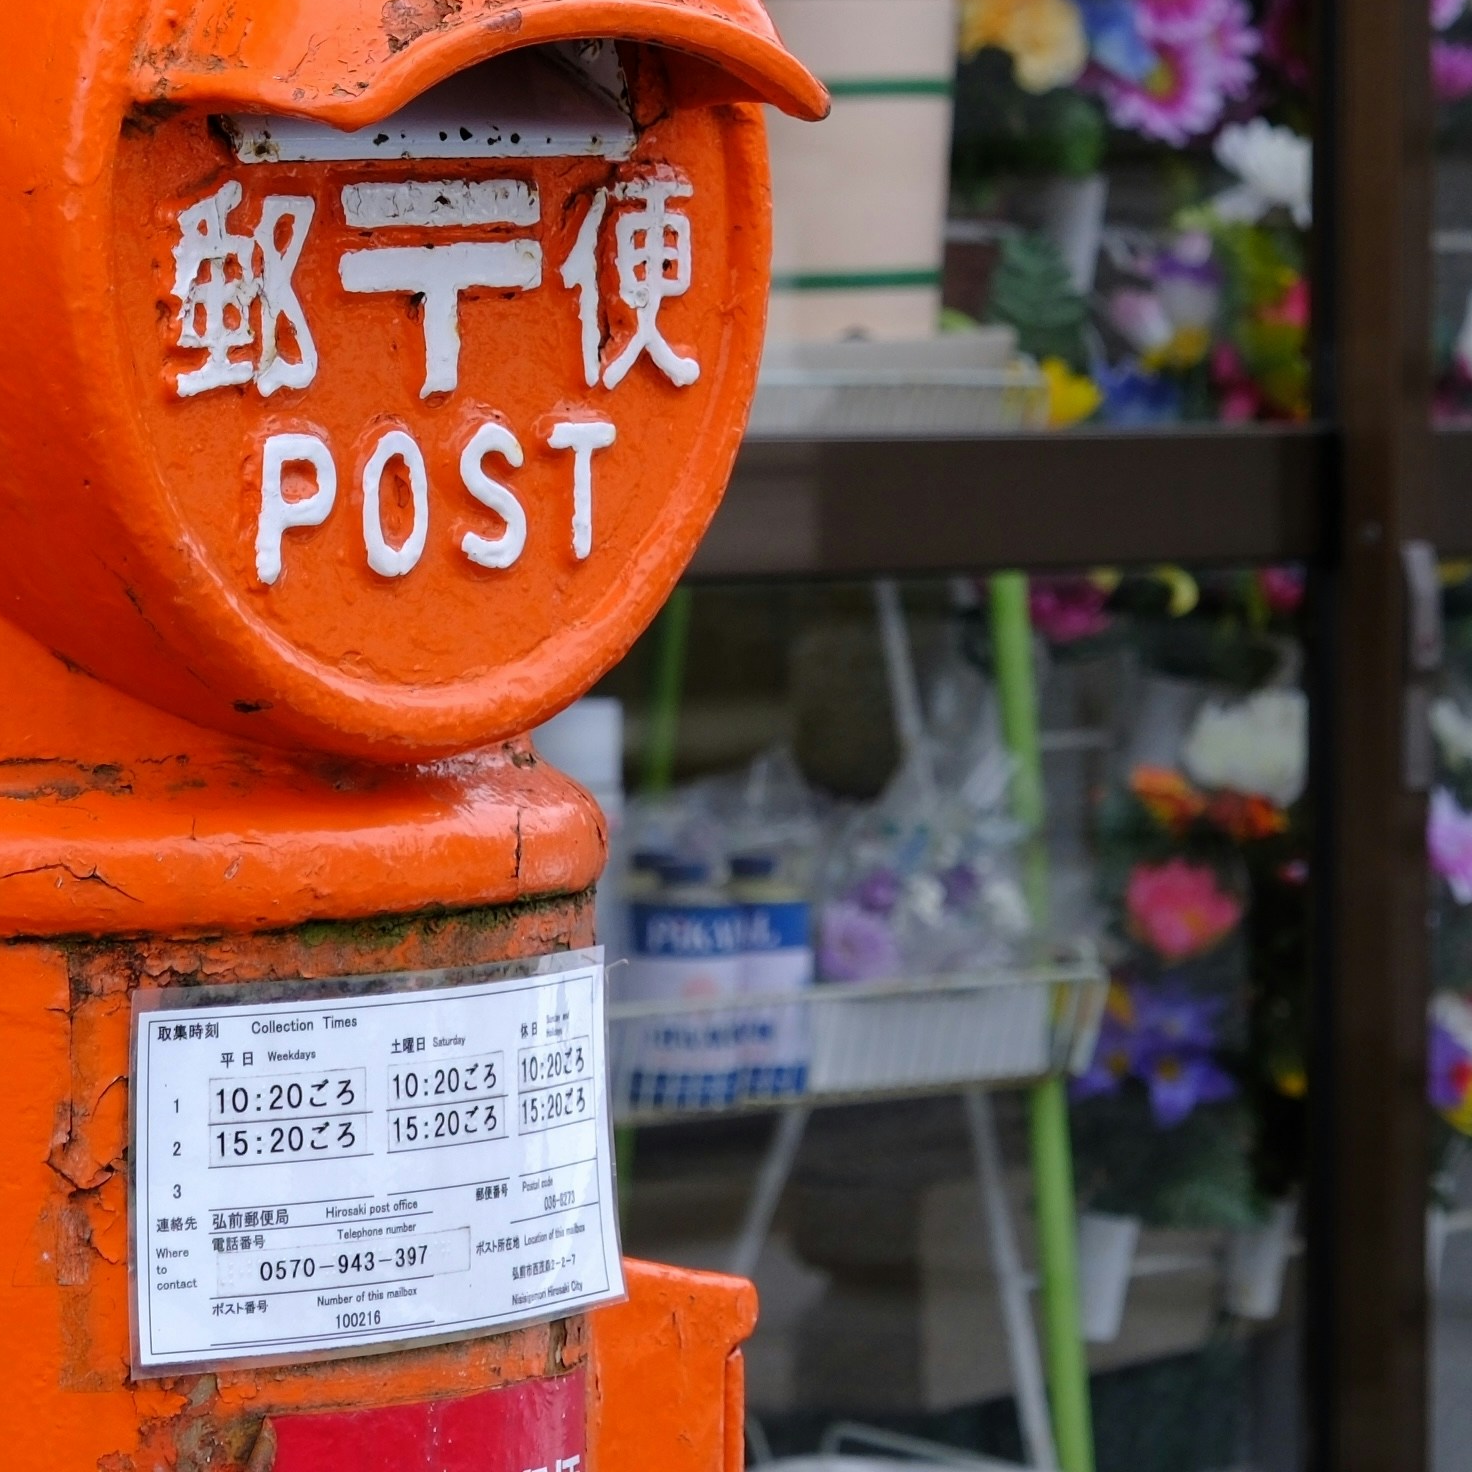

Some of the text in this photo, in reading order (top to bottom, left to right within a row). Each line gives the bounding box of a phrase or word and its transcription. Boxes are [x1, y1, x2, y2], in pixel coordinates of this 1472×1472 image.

[255, 420, 616, 585] POST
[158, 1022, 219, 1041] 取集時刻
[252, 1016, 357, 1034] Collection Times
[391, 1037, 426, 1054] 土曜日
[432, 1035, 466, 1047] Saturday
[268, 1050, 316, 1062] Weekdays
[521, 1047, 585, 1083] 10:20ごろ
[392, 1063, 497, 1100] 10:20ごろ
[173, 1098, 180, 1113] 1
[216, 1079, 355, 1114] 10:20ごろ
[522, 1087, 586, 1125] 15:20ごろ
[392, 1105, 498, 1144] 15:20ごろ
[172, 1141, 182, 1156] 2
[216, 1122, 356, 1157] 15:20ごろ
[172, 1184, 182, 1199] 3
[475, 1183, 508, 1201] 郵便番号
[325, 1199, 418, 1218] Hirosaki post office
[156, 1216, 198, 1231] 連絡先
[212, 1208, 290, 1229] 弘前郵便局
[337, 1222, 416, 1240] Telephone number
[524, 1231, 547, 1246] Location
[212, 1234, 266, 1253] 電話番号
[156, 1248, 189, 1259] Where
[259, 1244, 429, 1281] 0570-943-397
[157, 1264, 168, 1275] to
[156, 1278, 198, 1291] contact
[317, 1286, 418, 1307] Number of this mailbox
[212, 1299, 269, 1316] ポスト番号
[335, 1309, 382, 1329] 100216
